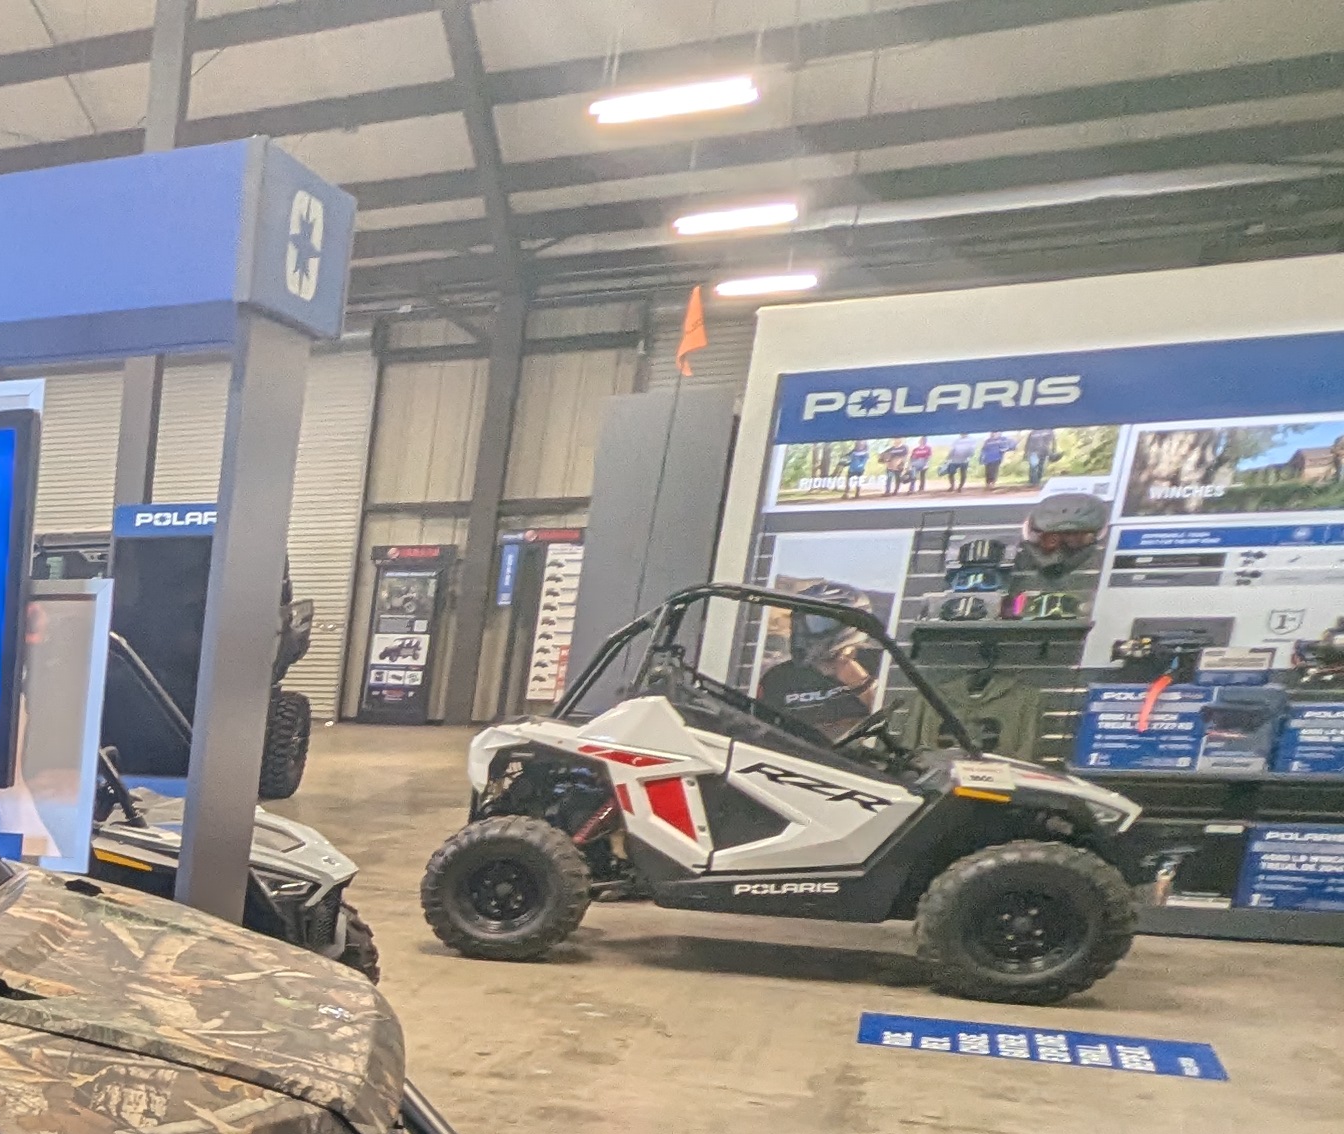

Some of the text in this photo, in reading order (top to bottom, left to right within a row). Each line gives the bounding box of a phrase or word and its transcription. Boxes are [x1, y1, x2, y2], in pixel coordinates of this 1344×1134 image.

[802, 375, 1082, 421] POLARIS
[799, 473, 887, 490] RIDING GEAR
[1149, 483, 1227, 500] WINCHES
[735, 762, 893, 814] RZR
[733, 881, 840, 896] POLARIS
